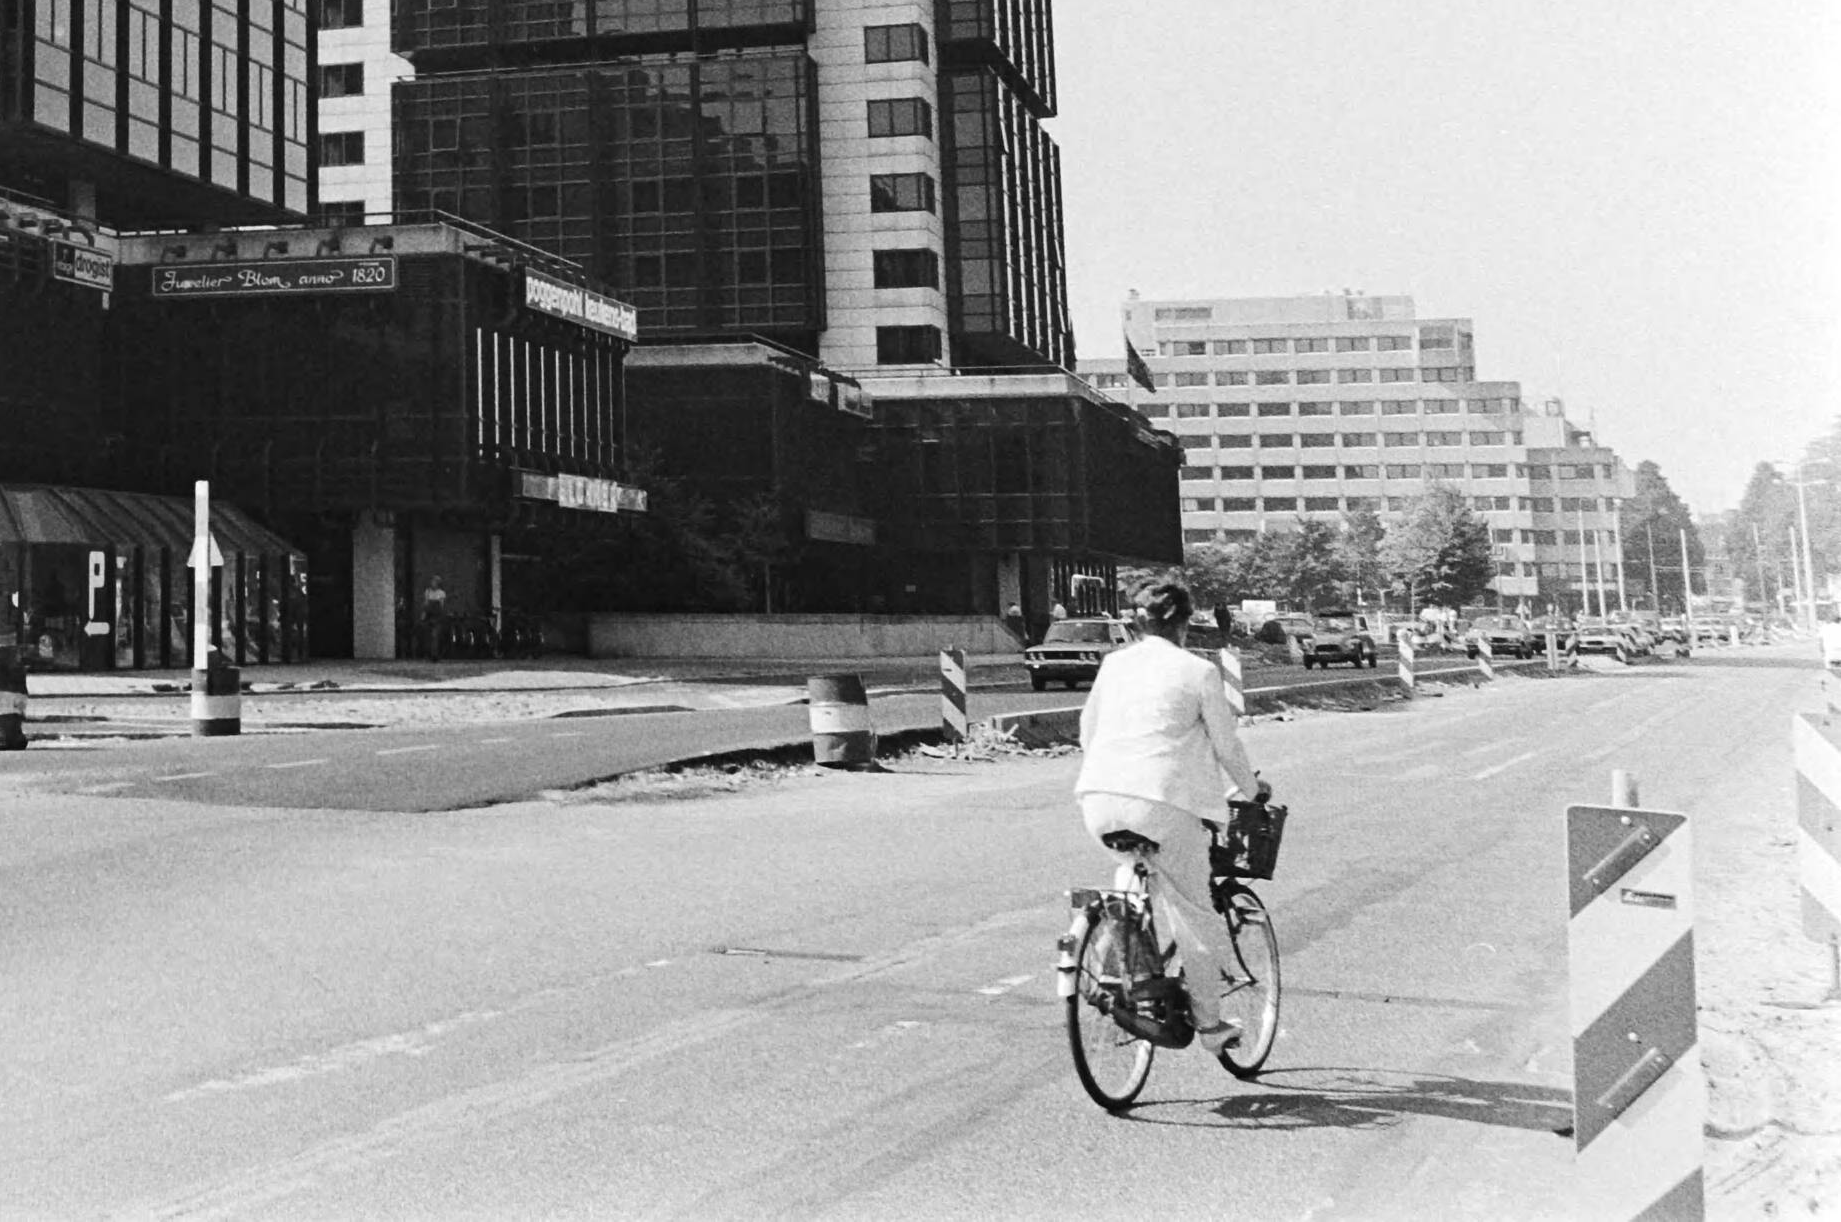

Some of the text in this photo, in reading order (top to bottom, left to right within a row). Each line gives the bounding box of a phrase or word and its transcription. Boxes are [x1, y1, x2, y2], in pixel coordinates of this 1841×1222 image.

[76, 253, 110, 280] drogist
[298, 269, 344, 285] anno
[352, 266, 386, 284] 1820
[88, 550, 106, 620] P
